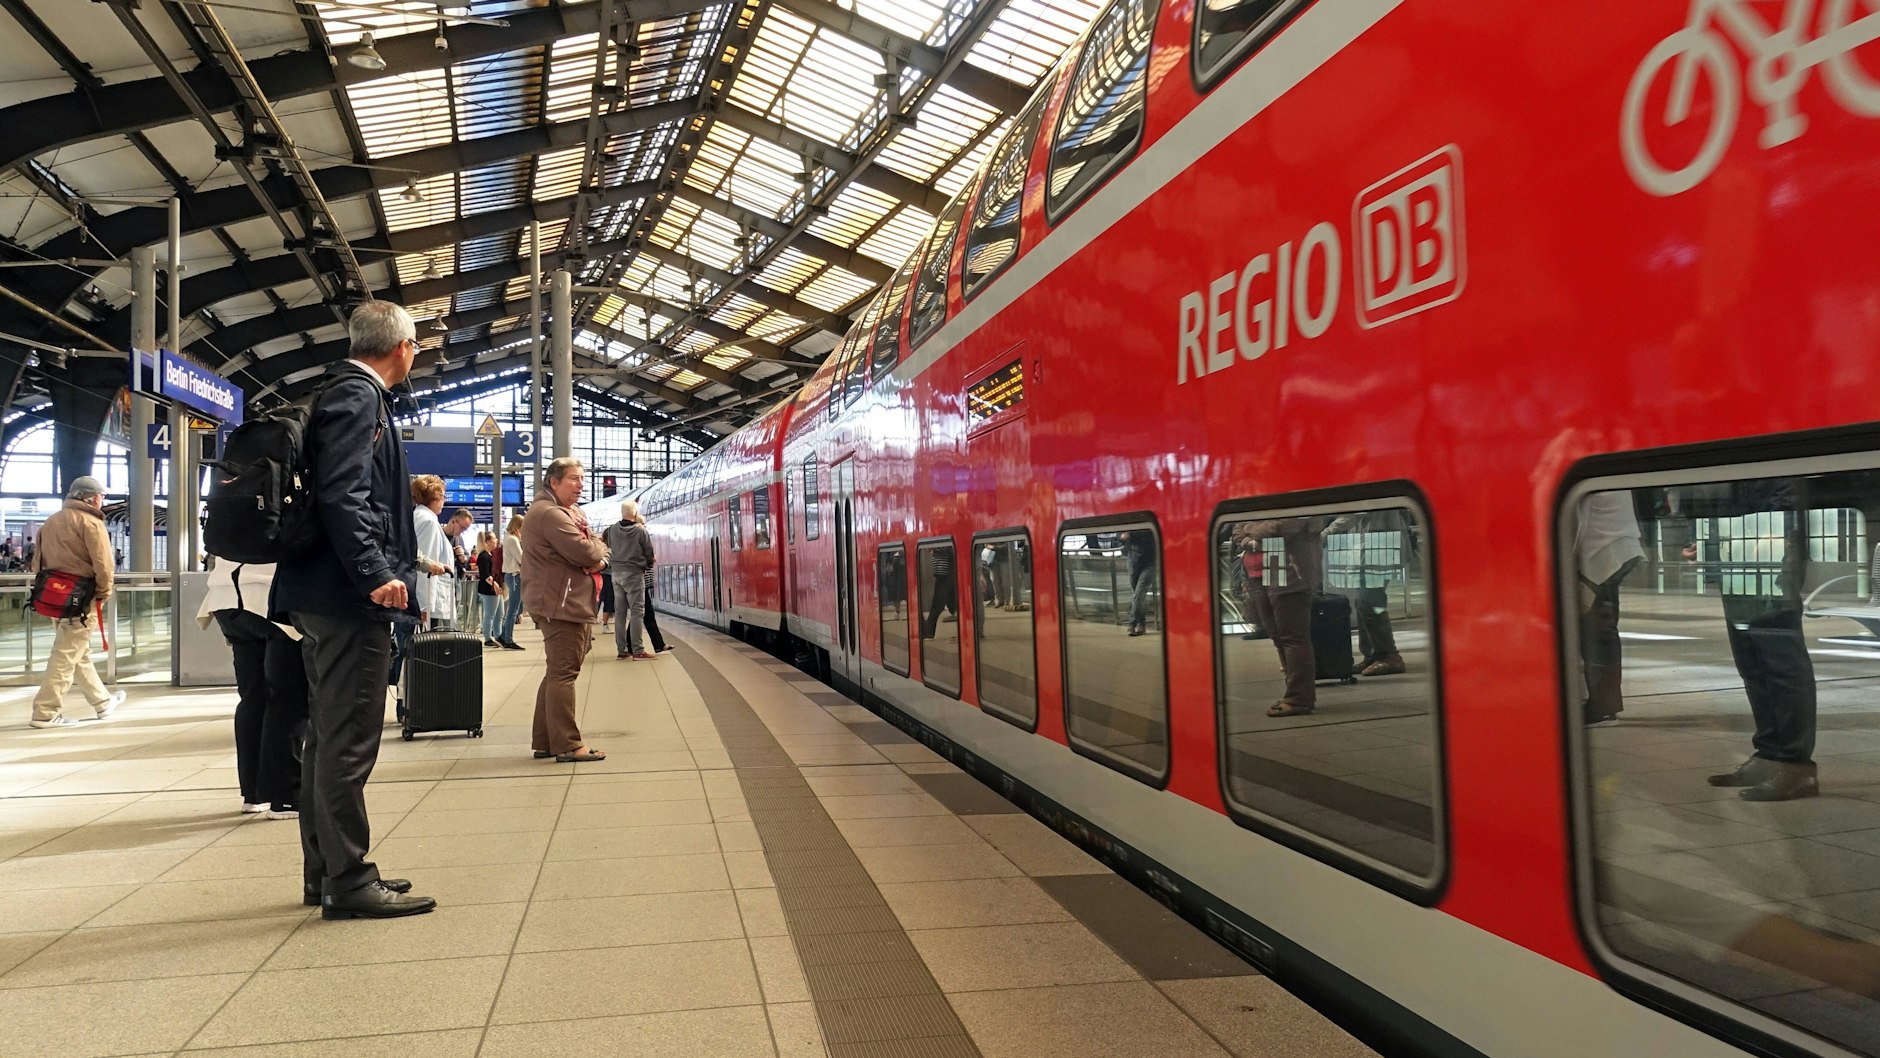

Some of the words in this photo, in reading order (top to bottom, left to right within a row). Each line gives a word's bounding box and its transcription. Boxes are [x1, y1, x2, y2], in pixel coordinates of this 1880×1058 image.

[1177, 221, 1342, 385] REGIO
[1369, 185, 1447, 302] DB
[166, 359, 189, 390] Berlin
[189, 371, 234, 410] Friedrichstraße
[152, 424, 171, 451] 4
[517, 431, 535, 457] 3
